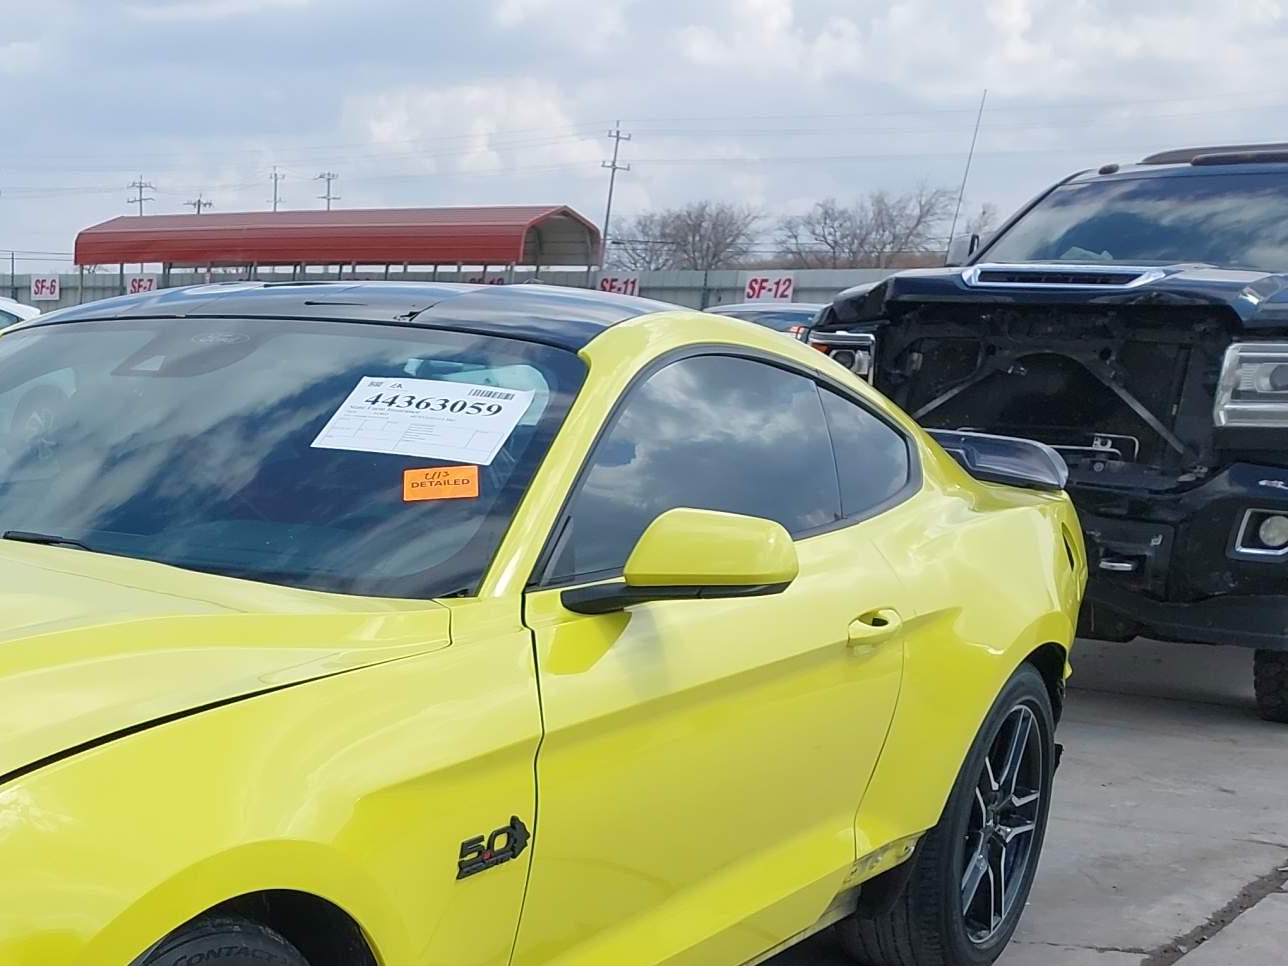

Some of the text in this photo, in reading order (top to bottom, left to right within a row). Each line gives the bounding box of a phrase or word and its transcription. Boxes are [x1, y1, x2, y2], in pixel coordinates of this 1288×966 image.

[33, 279, 56, 296] SF-6
[130, 277, 153, 294] SF-7
[600, 277, 638, 296] SF-11
[746, 278, 792, 299] SF-12
[364, 392, 503, 417] 44363059
[411, 478, 470, 489] DETAILED
